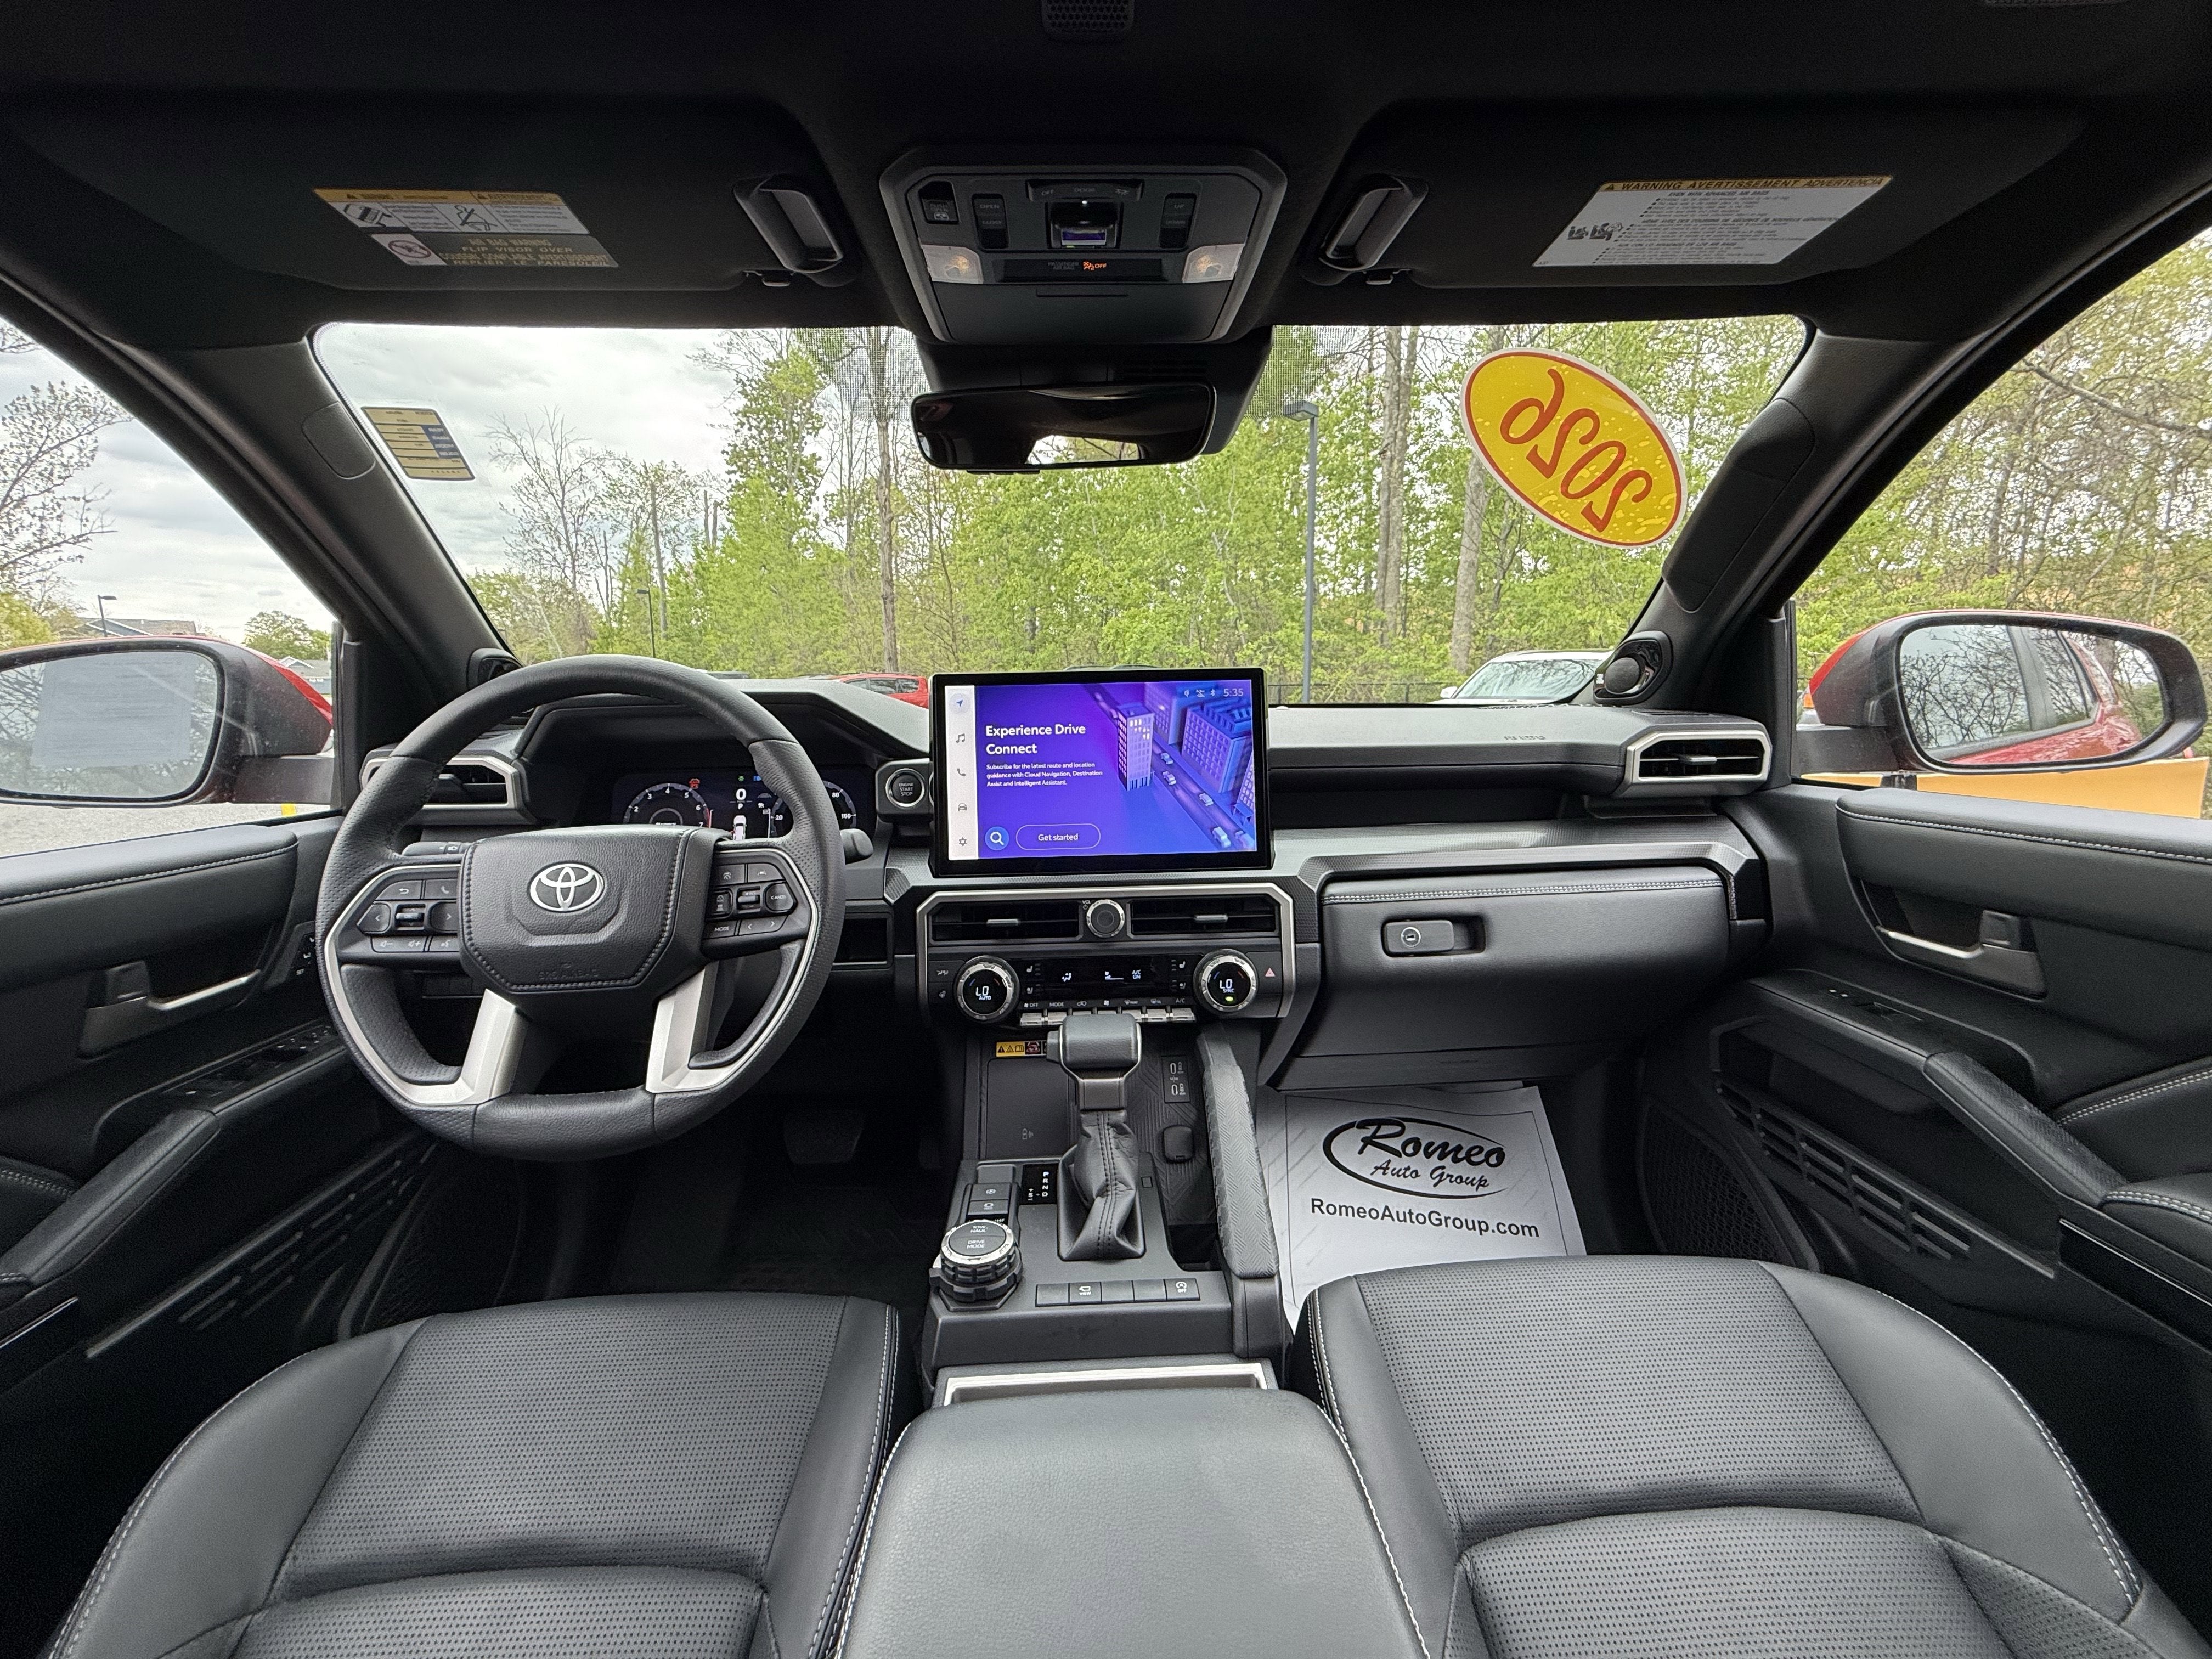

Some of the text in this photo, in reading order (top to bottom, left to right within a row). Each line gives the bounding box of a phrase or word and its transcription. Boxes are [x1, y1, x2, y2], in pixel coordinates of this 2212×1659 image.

[1622, 182, 1683, 190] WARNING
[1687, 179, 1800, 189] AVERTISSEMENT
[1223, 688, 1244, 697] 5:35
[986, 724, 1086, 738] Experience Drive
[986, 743, 1038, 755] Connect
[736, 788, 747, 800] 0
[1053, 832, 1079, 841] started
[1219, 979, 1233, 989] LO
[975, 986, 989, 996] LO
[1355, 1118, 1505, 1168] Romeo
[1370, 1159, 1490, 1192] Auto Group
[1311, 1198, 1540, 1238] RomeoAutoGroup.com
